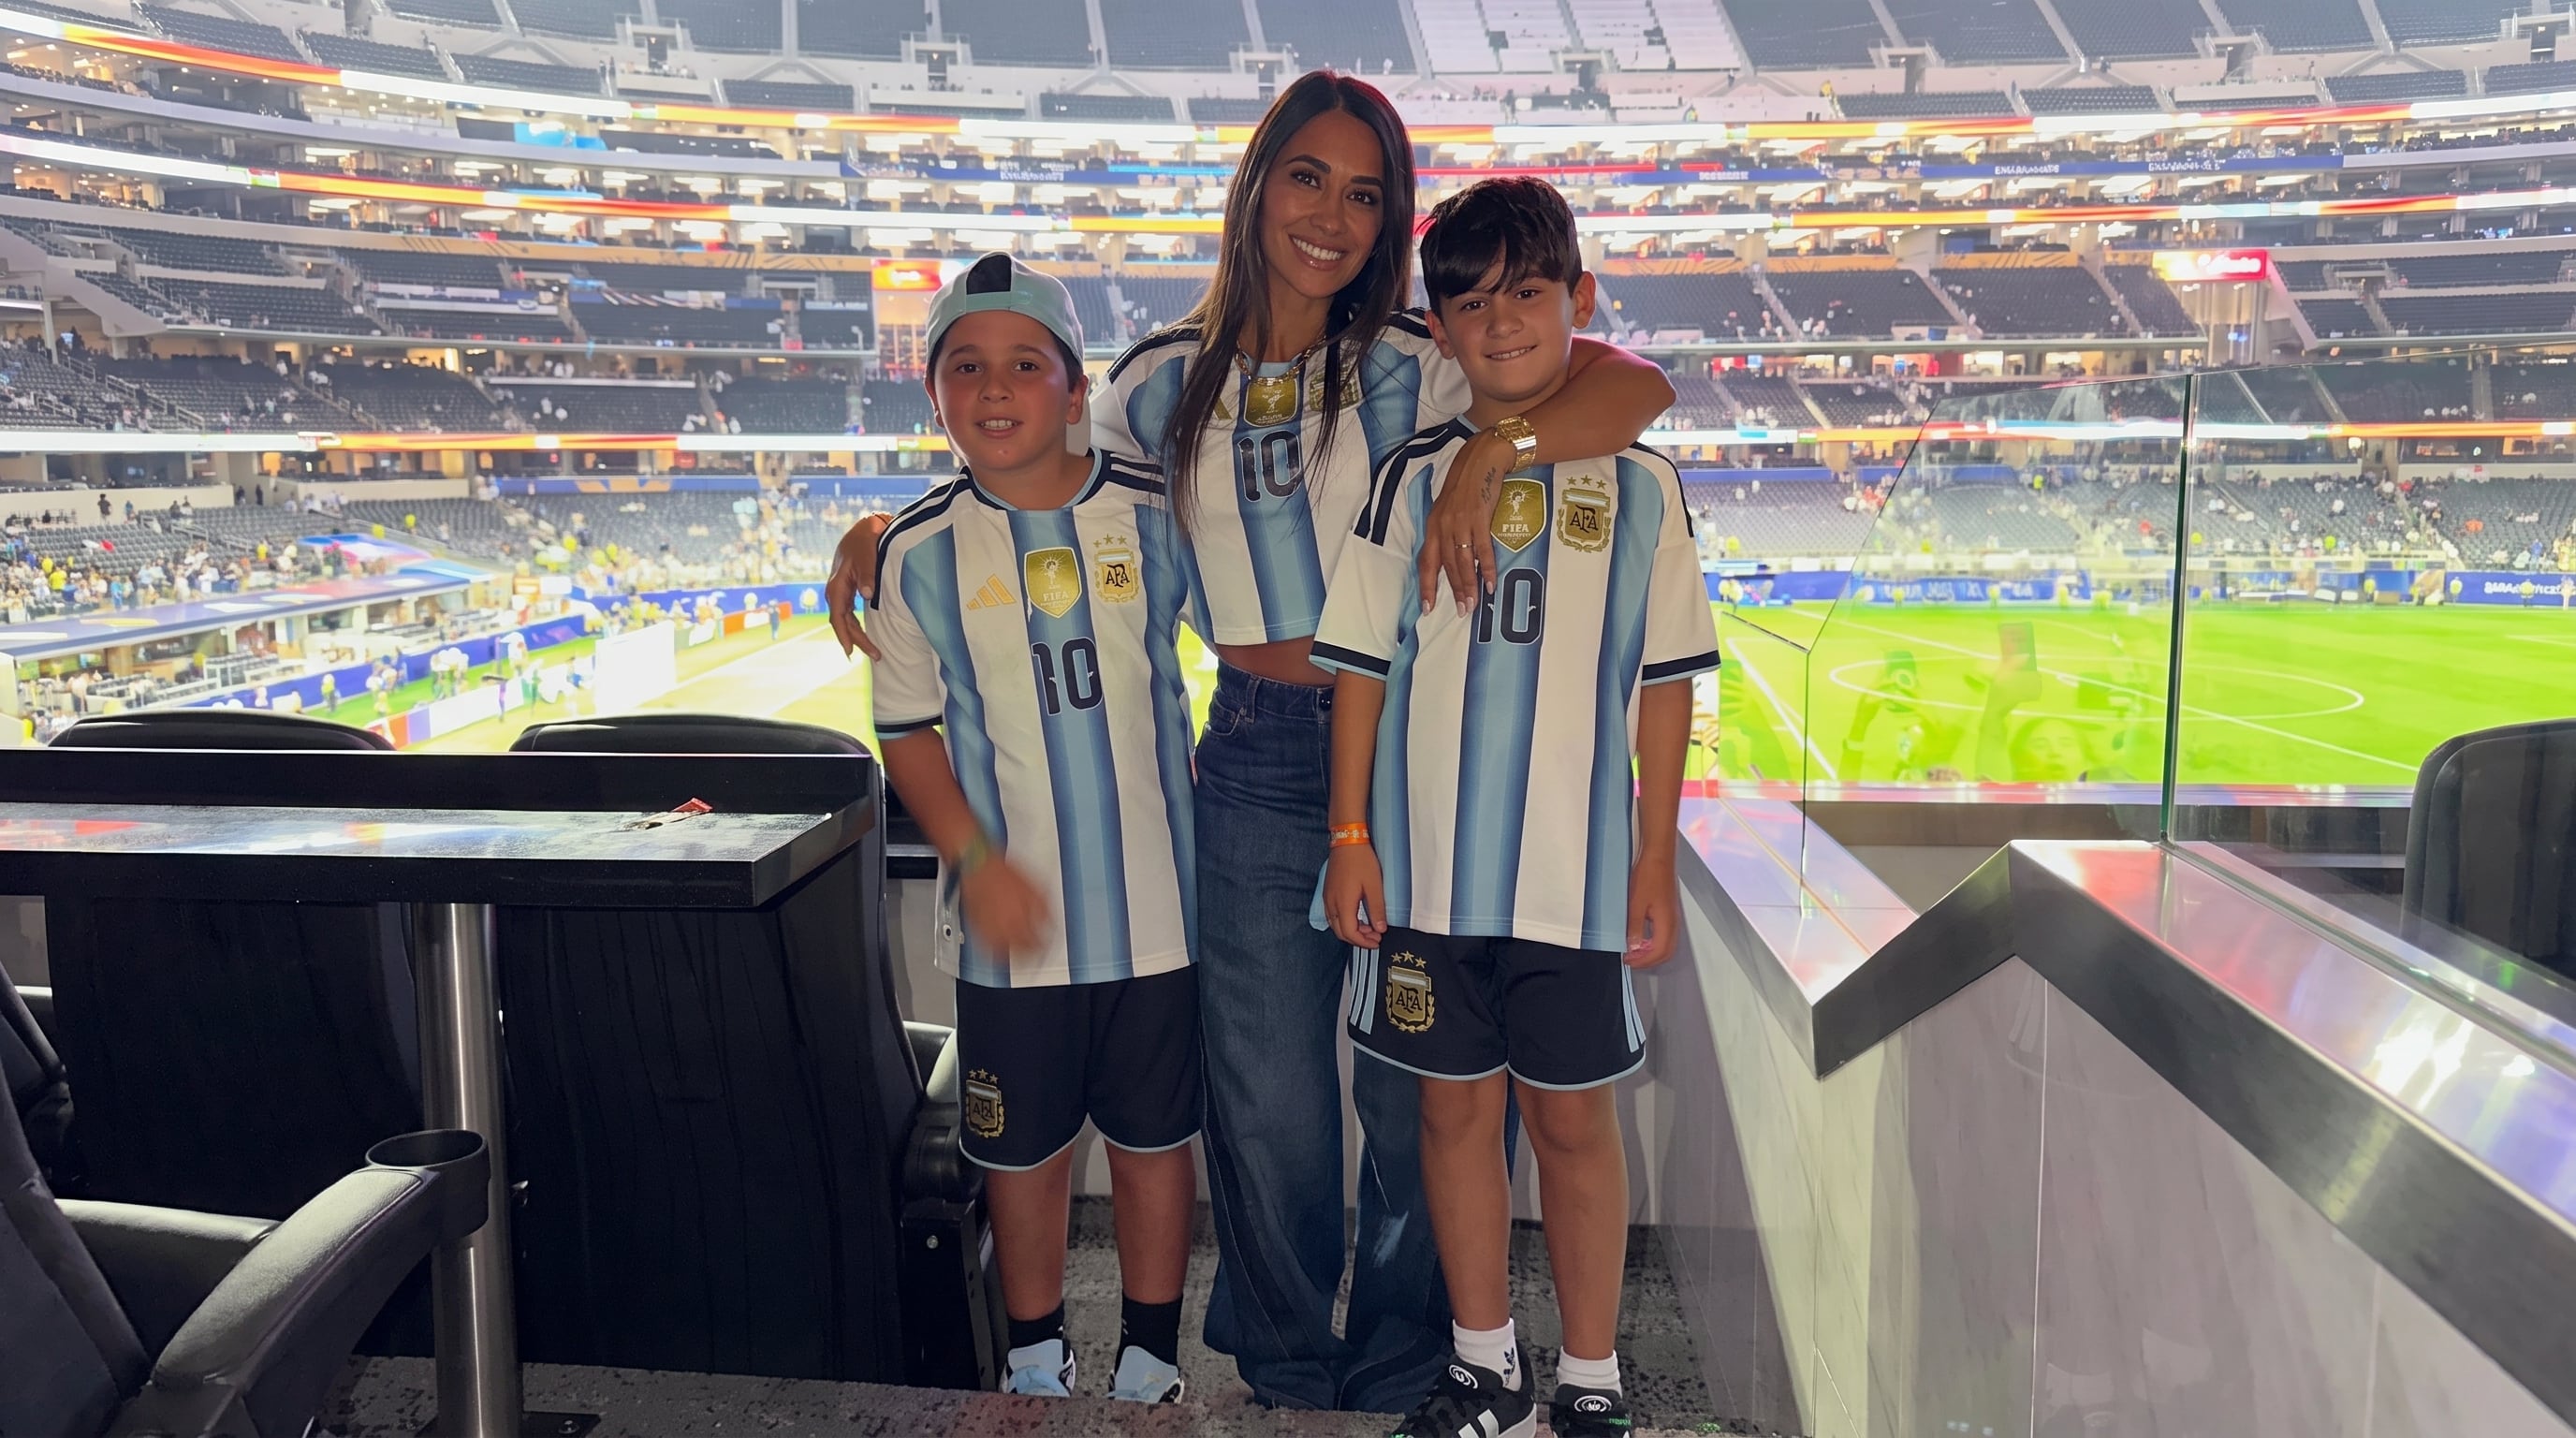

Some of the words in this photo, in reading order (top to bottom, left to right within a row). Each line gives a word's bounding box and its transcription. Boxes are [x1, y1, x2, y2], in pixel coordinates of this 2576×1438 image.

[1237, 430, 1304, 502] 10
[1570, 505, 1599, 534] AFA
[1032, 637, 1103, 716] 10
[1396, 985, 1423, 1014] AFA
